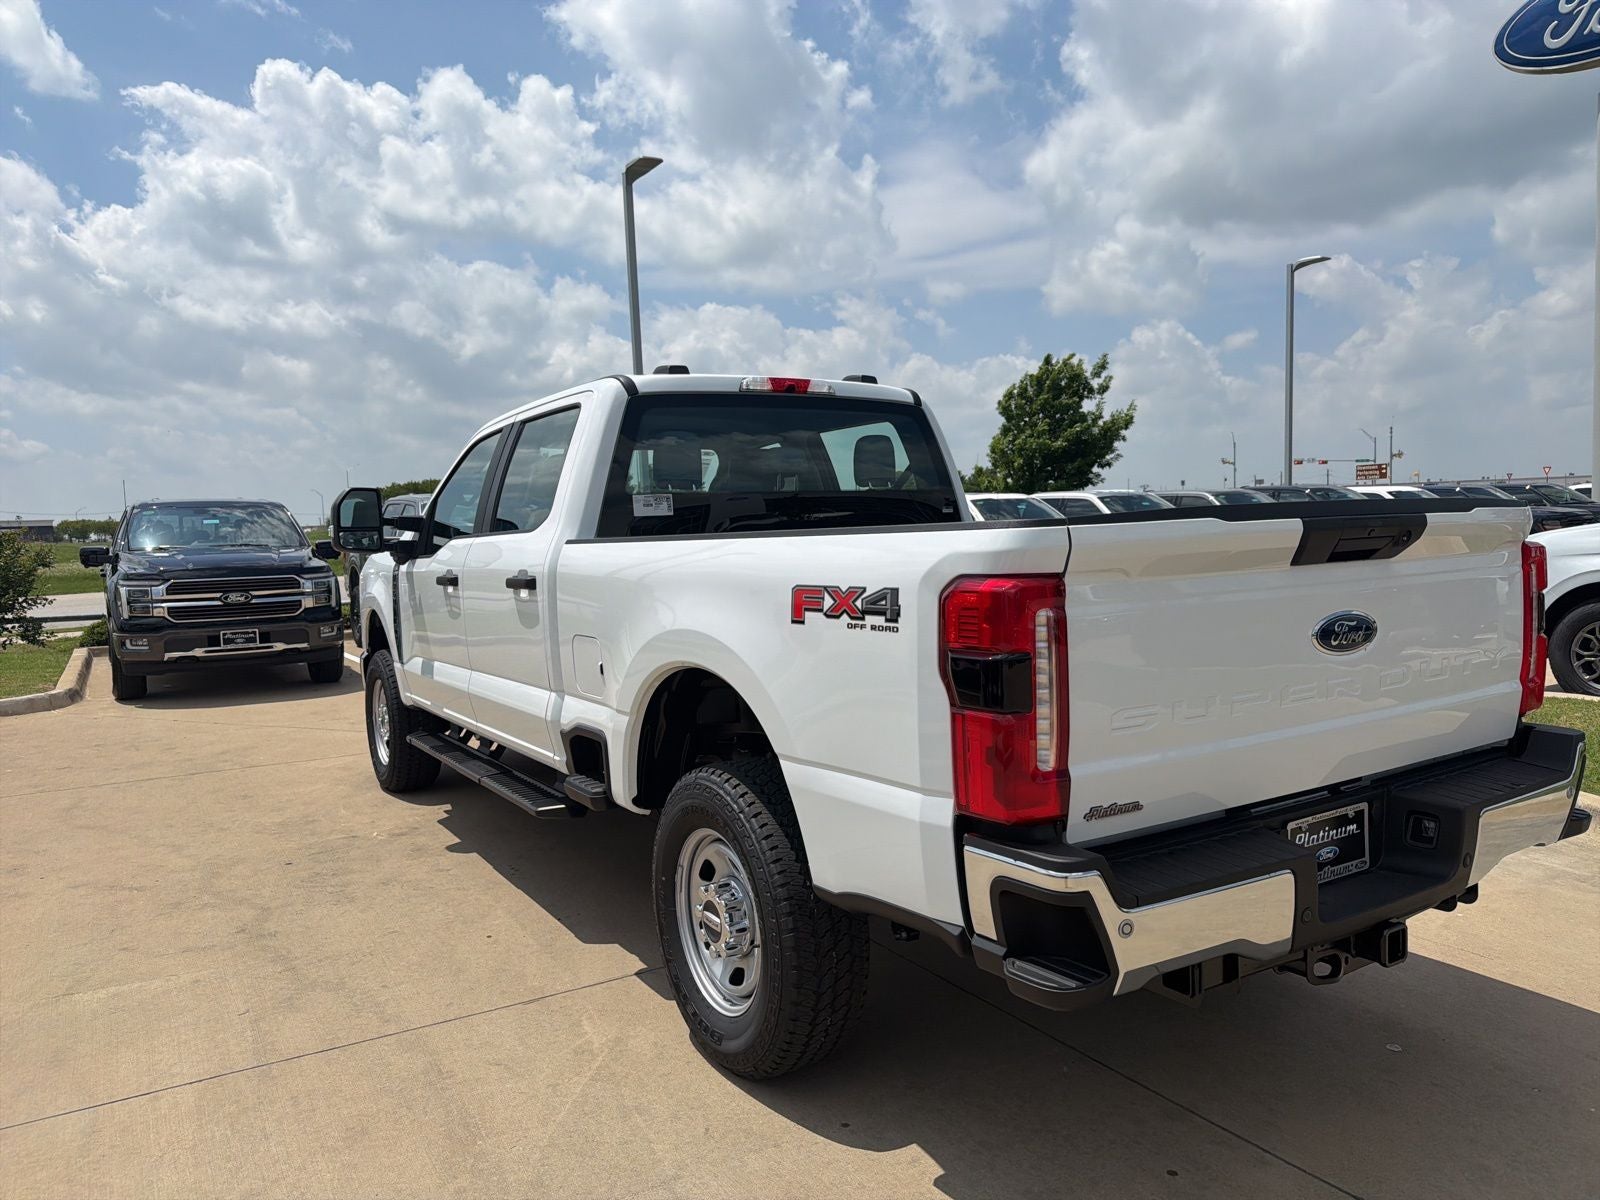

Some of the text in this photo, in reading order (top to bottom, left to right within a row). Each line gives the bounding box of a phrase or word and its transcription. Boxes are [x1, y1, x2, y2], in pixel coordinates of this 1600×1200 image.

[791, 585, 901, 625] FX4
[846, 622, 899, 633] OFF ROAD
[1331, 620, 1370, 645] Ford
[1110, 647, 1509, 736] SUPER DUTY
[1083, 801, 1143, 821] Platinum
[1295, 823, 1361, 847] Platinum
